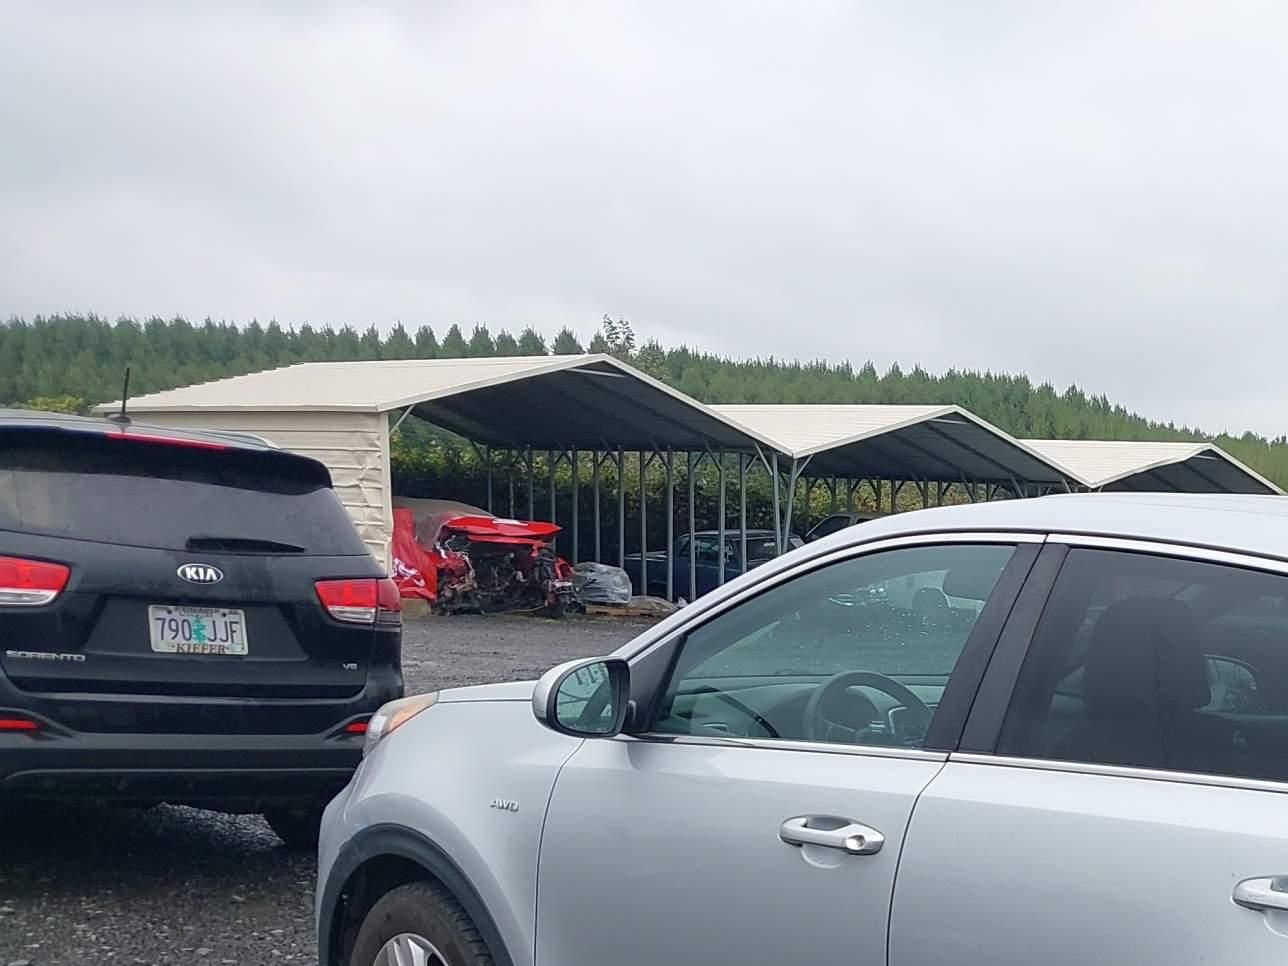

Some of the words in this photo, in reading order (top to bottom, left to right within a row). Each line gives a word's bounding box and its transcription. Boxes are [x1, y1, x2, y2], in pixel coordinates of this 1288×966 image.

[185, 567, 218, 580] KIA
[155, 617, 193, 641] 790
[207, 620, 239, 643] JJF
[177, 643, 227, 655] KIEFER
[6, 650, 86, 662] SORENTO
[490, 799, 519, 812] AWD
